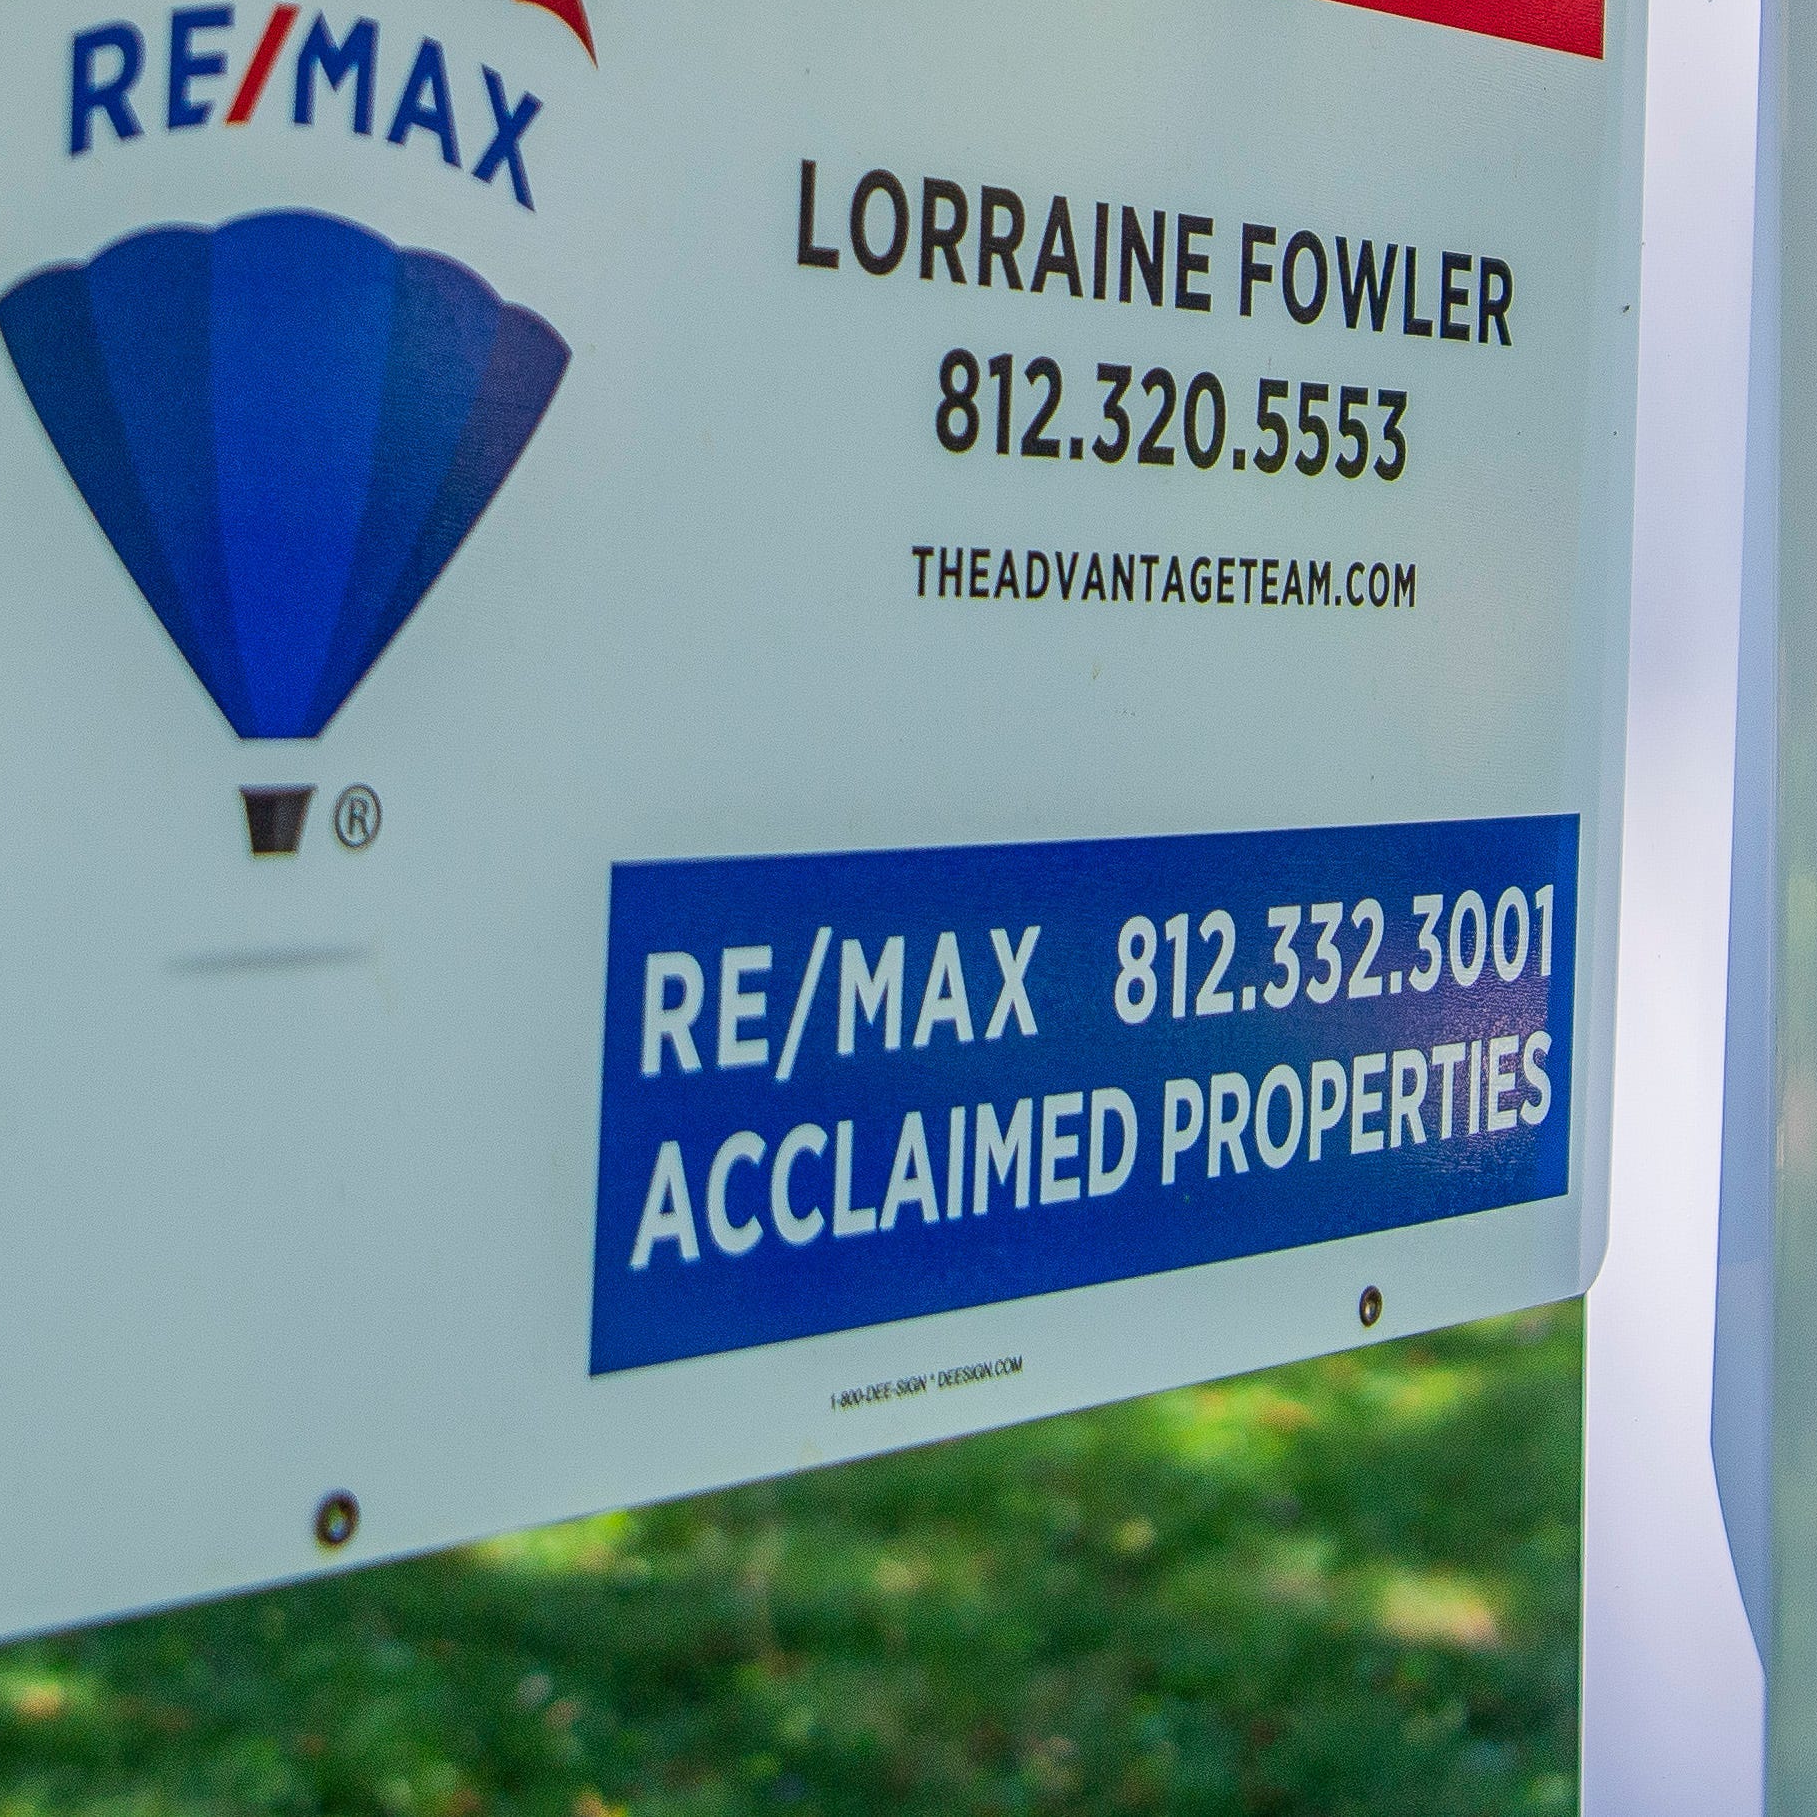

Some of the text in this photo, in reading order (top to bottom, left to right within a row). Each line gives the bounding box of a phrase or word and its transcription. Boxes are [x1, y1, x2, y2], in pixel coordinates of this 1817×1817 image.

[69, 3, 543, 212] RE/MAX
[796, 159, 1514, 347] LORRAINE FOWLER
[934, 348, 1409, 481] 812.320.5553
[911, 546, 1417, 609] THEADVANTAGETEAM.COM
[641, 884, 1554, 1080] RE/MAX 812.332.3001
[629, 1030, 1553, 1270] ACCLAIMED PROPERTIES
